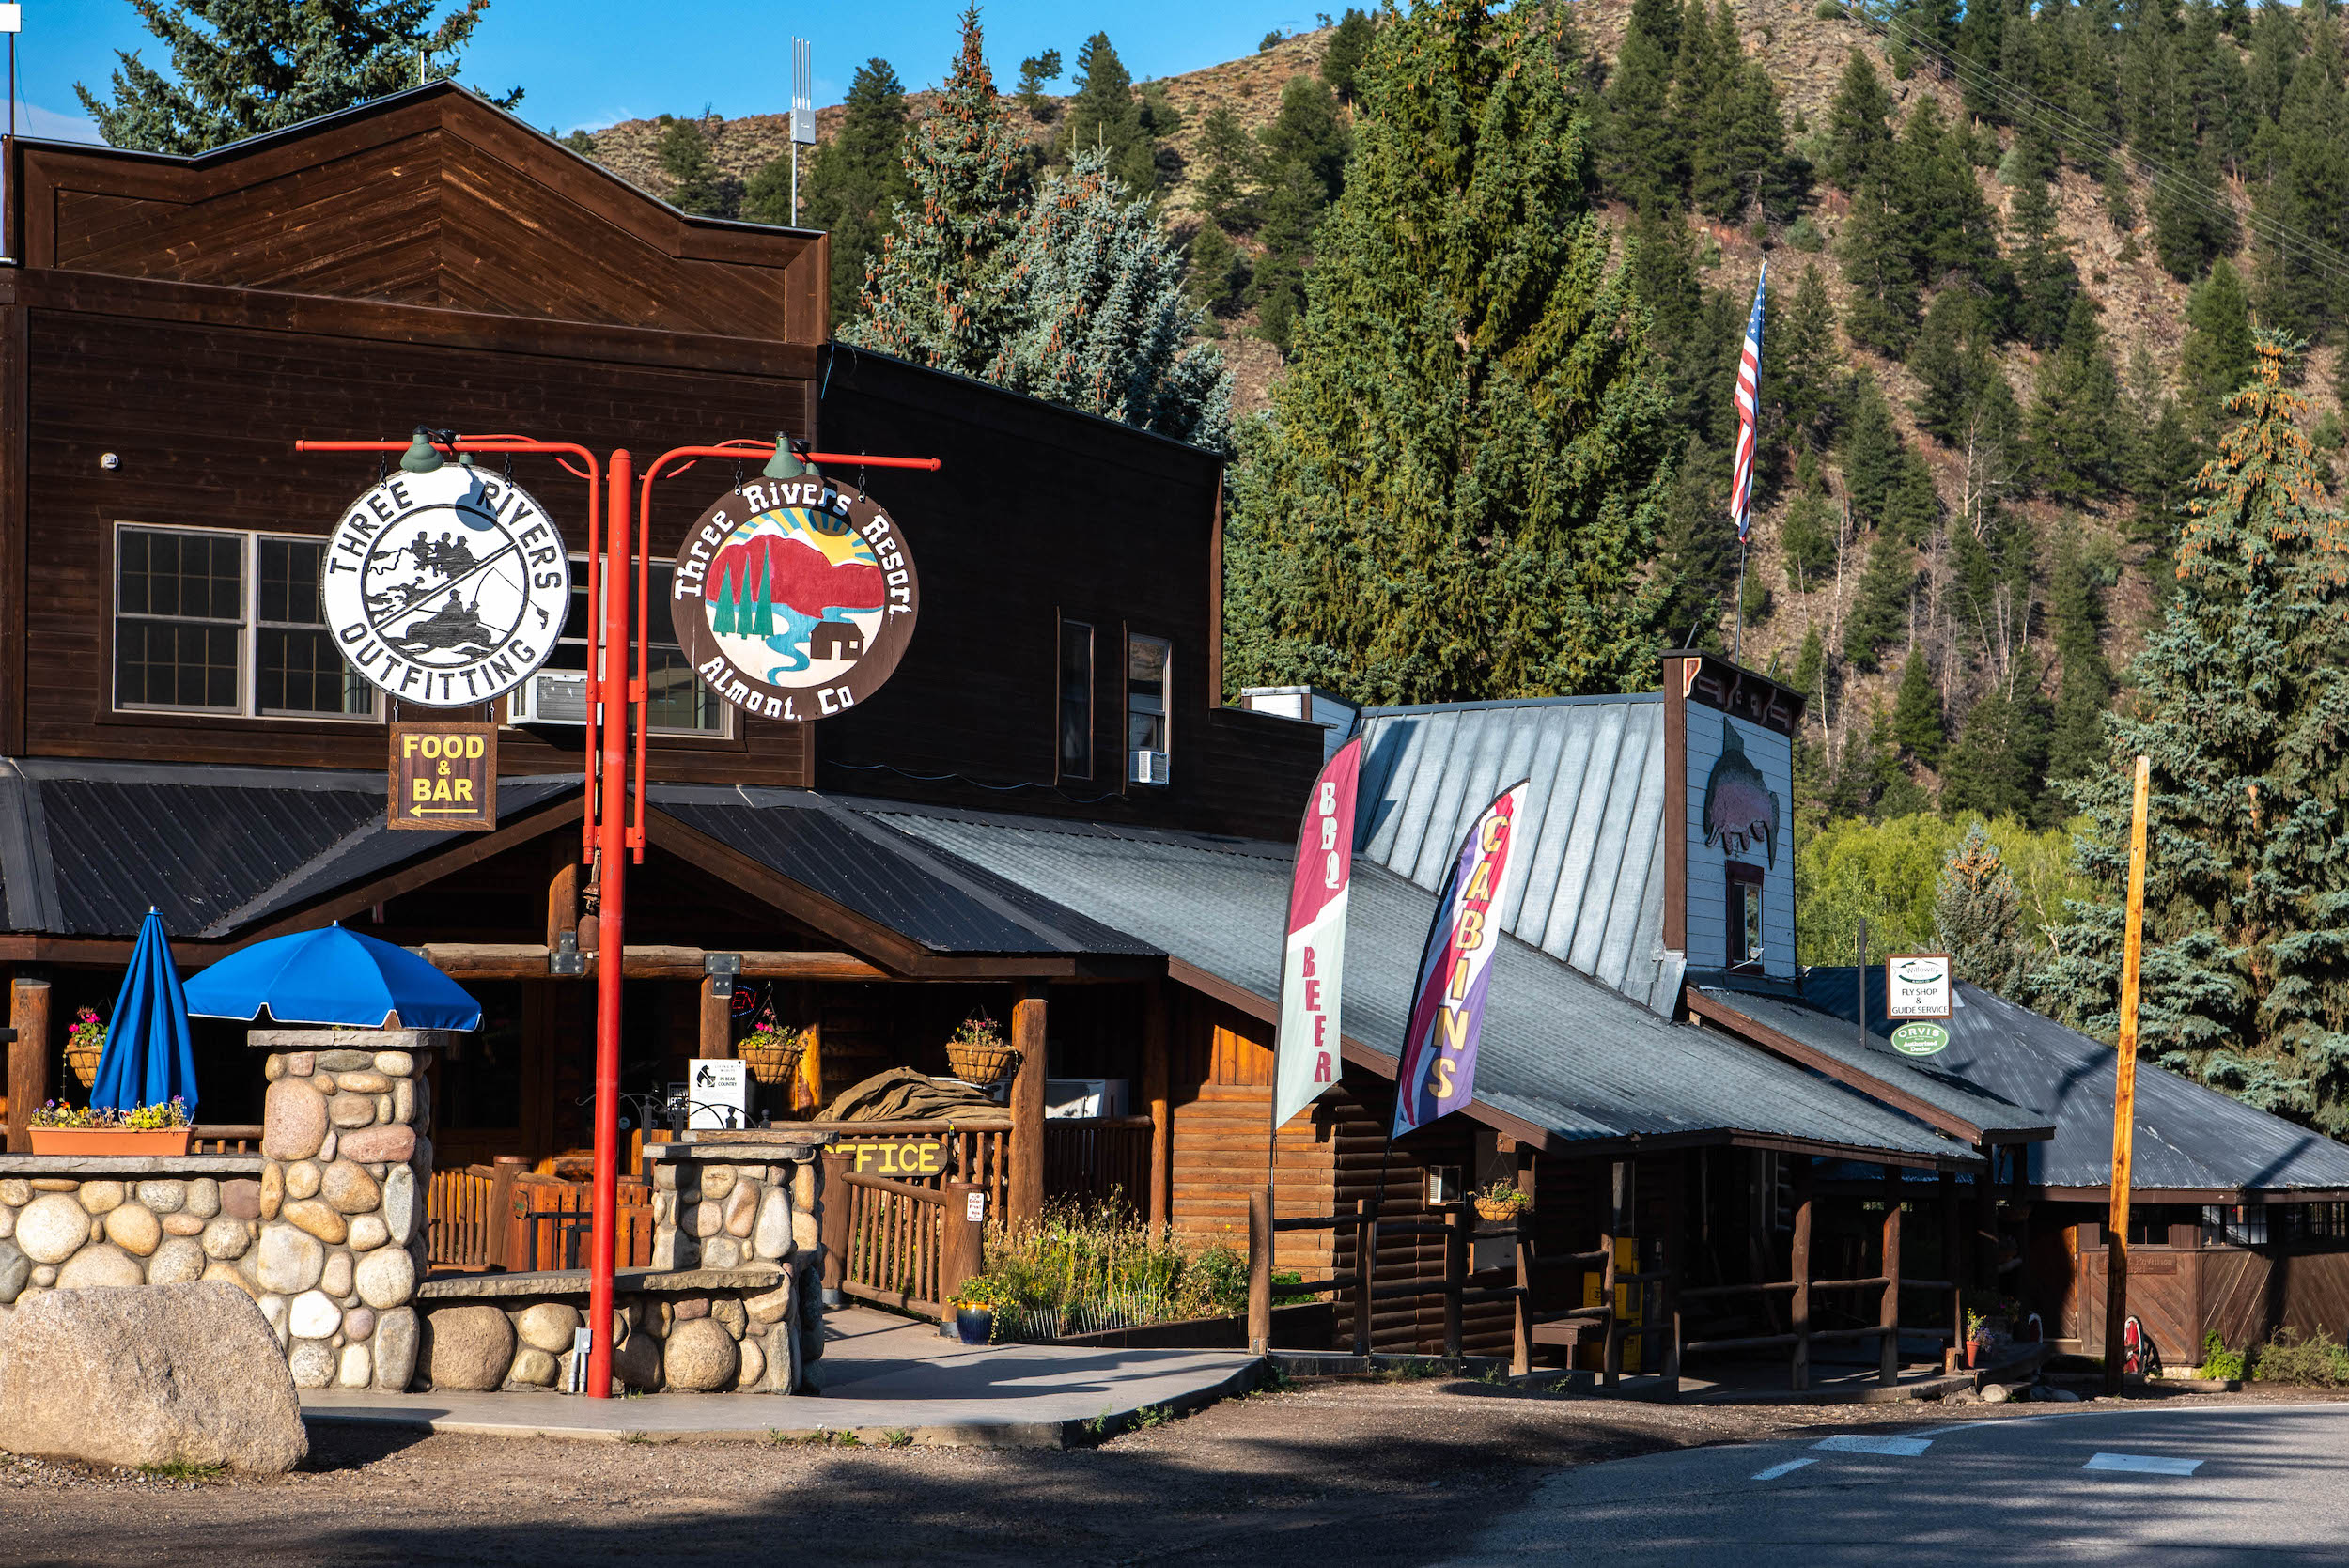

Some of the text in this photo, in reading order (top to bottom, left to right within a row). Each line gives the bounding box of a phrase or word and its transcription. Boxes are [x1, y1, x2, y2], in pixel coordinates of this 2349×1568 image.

[330, 480, 562, 590] THREE RIVERS
[674, 481, 912, 616] Three Rivers Resort
[340, 622, 536, 701] OUTFITTING
[698, 655, 855, 722] Almont, Co
[402, 735, 485, 759] FOOD
[437, 760, 451, 776] &
[412, 778, 474, 802] BAR
[1317, 781, 1341, 891] BBQ
[1427, 815, 1509, 1099] CABINS
[1301, 945, 1332, 1083] BEER
[1898, 1027, 1941, 1038] ORVIS
[1917, 1005, 1948, 1014] SERVICE
